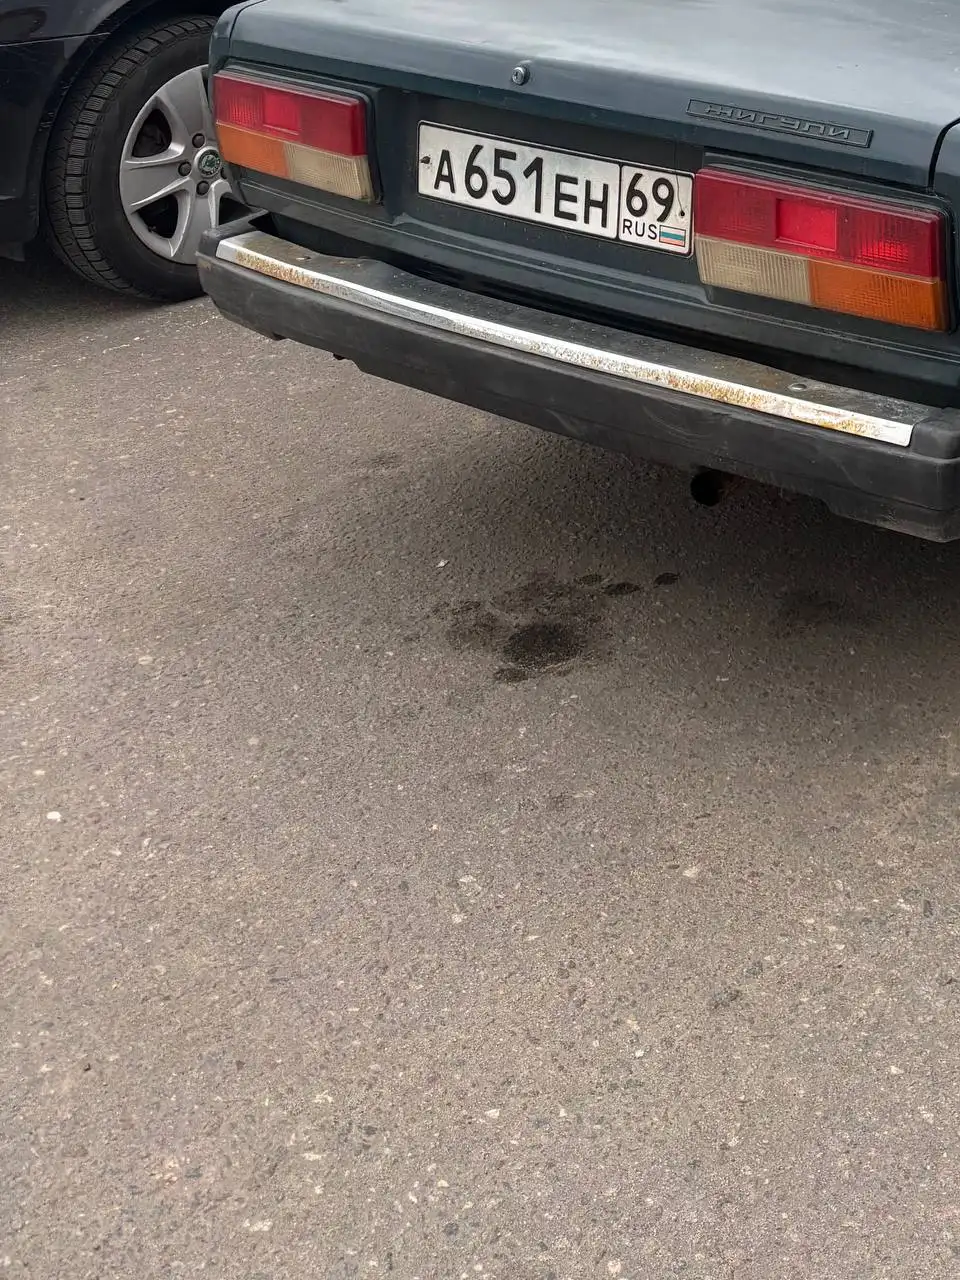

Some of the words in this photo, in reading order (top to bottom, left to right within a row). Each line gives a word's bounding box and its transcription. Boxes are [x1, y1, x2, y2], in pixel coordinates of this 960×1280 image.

[433, 144, 609, 229] А651ЕН
[625, 172, 675, 222] 69
[622, 218, 658, 241] RUS
